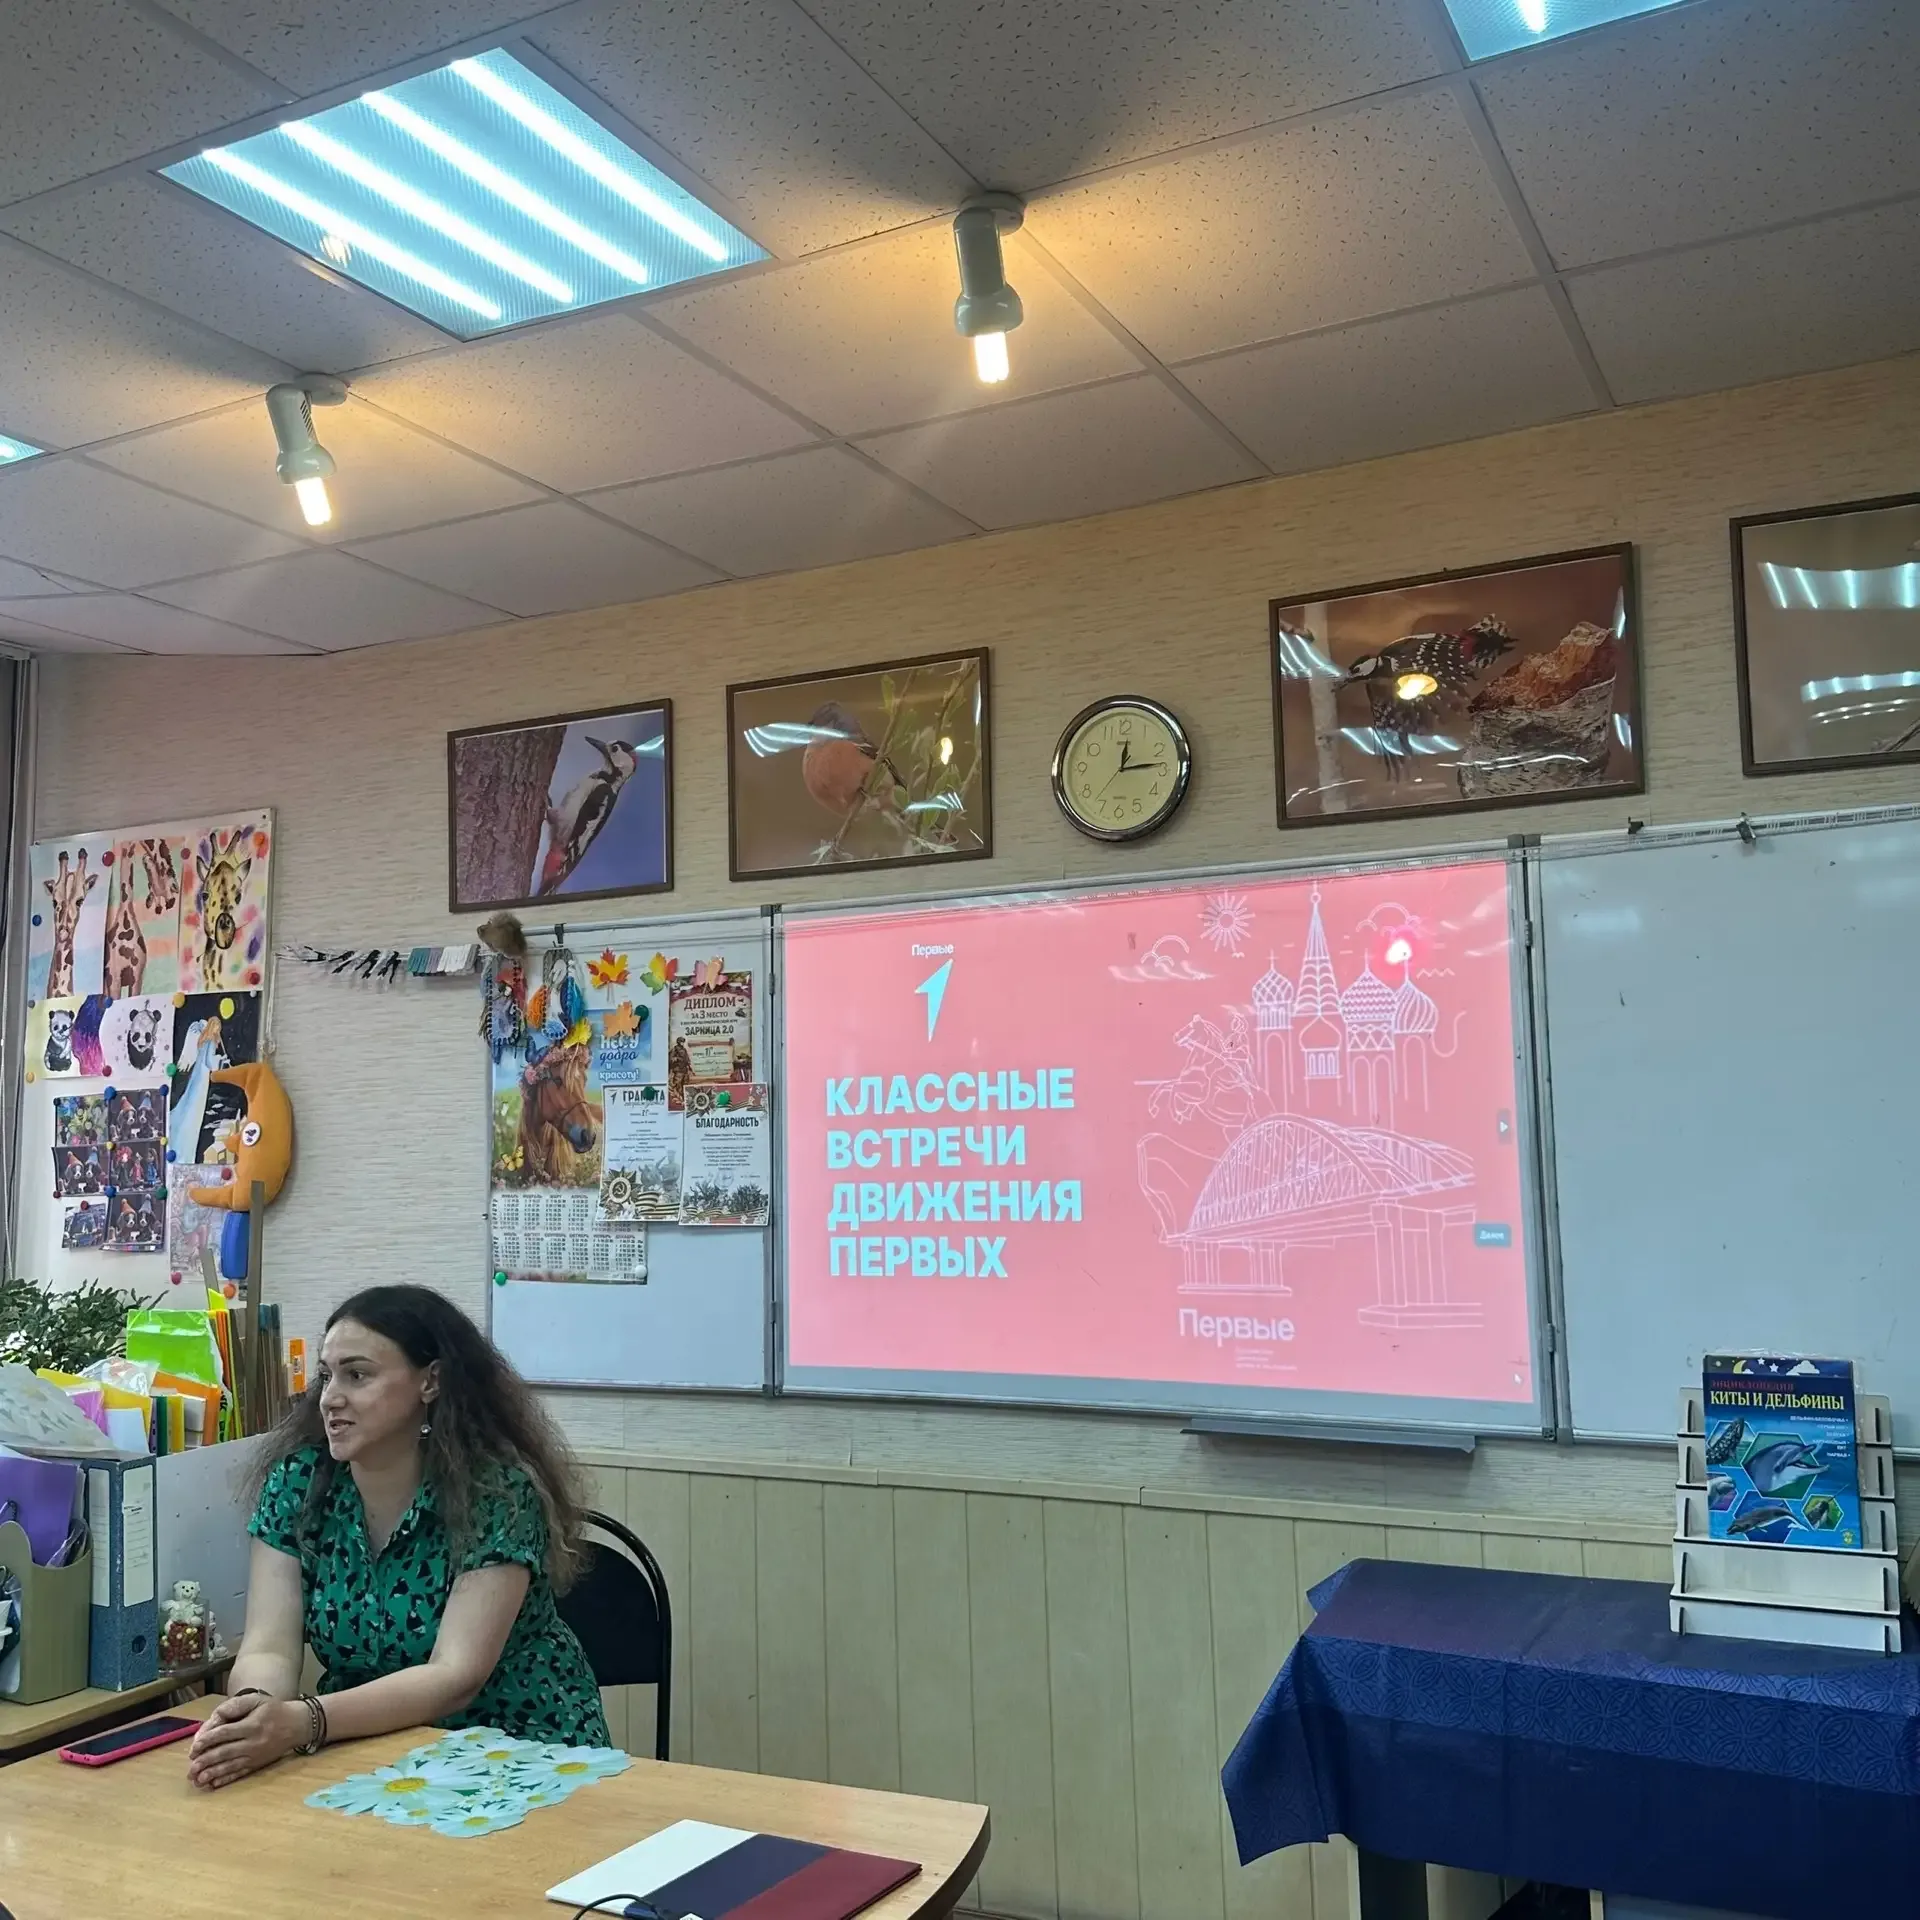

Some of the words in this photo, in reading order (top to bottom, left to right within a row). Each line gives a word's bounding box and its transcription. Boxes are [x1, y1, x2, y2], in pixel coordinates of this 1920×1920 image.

[1103, 725, 1114, 740] 11
[1119, 719, 1132, 735] 12
[1087, 742, 1101, 757] 10
[1154, 742, 1166, 758] 2
[1077, 761, 1088, 776] 9
[1158, 761, 1168, 777] 3
[1081, 784, 1092, 799] 8
[1149, 782, 1159, 796] 4
[1098, 799, 1107, 814] 7
[1113, 804, 1124, 819] 6
[1132, 799, 1142, 814] 5
[684, 996, 736, 1011] ДИПЛОМ
[700, 1010, 706, 1019] 3
[706, 1010, 728, 1019] МЕСТО
[685, 1024, 720, 1036] ЗАРНИЦА
[623, 1090, 666, 1102] ГРАТА
[826, 1068, 1075, 1117] КЛАССНЫЕ
[695, 1117, 759, 1129] БЛАГОДАРНОСТЬ
[827, 1125, 1026, 1169] ВСТРЕЧИ
[828, 1180, 1083, 1231] ДВИЖЕНИЯ
[830, 1237, 1008, 1278] ПЕРВЫХ
[1179, 1308, 1296, 1348] Первые
[1710, 1391, 1750, 1406] КИТЫ
[1753, 1392, 1763, 1406] И
[1765, 1393, 1845, 1410] ДЕЛЬФИНЫ
